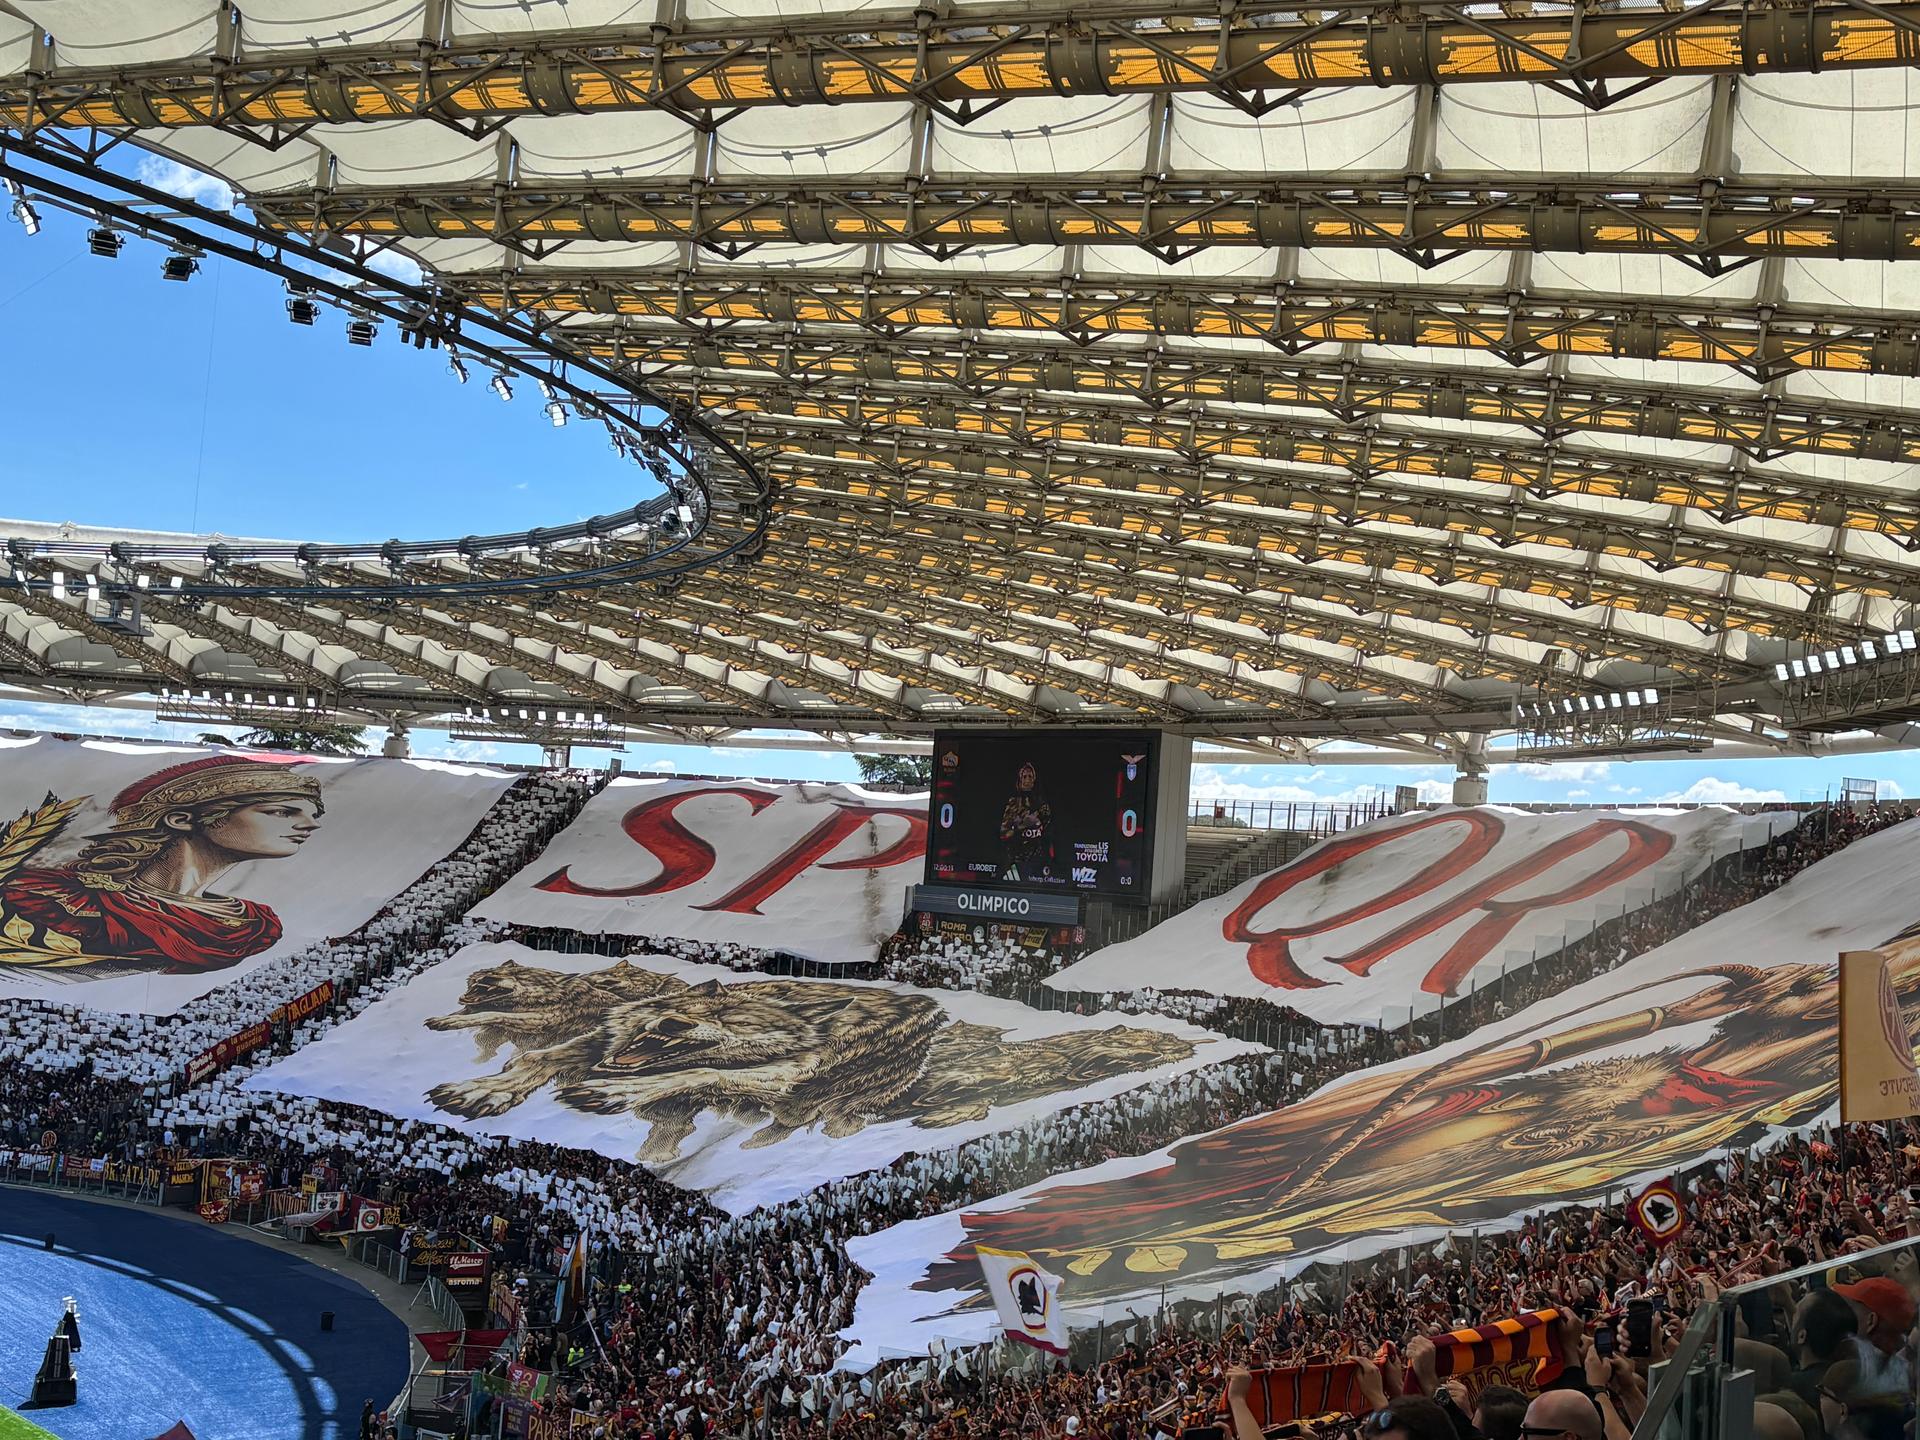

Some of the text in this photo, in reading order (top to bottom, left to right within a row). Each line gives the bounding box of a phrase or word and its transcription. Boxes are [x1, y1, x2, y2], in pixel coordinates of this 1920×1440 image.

[940, 803, 953, 828] 0
[1122, 809, 1136, 837] 0
[1098, 841, 1109, 849] LIS
[1075, 852, 1108, 863] TOYOTA
[968, 863, 997, 872] EUROBET
[957, 893, 1030, 915] OLIMPICO
[940, 920, 967, 932] ROMA
[287, 985, 331, 1019] MAGLIANA
[239, 1023, 267, 1041] vecchia
[235, 1036, 263, 1055] guardia
[448, 1277, 480, 1286] asroma
